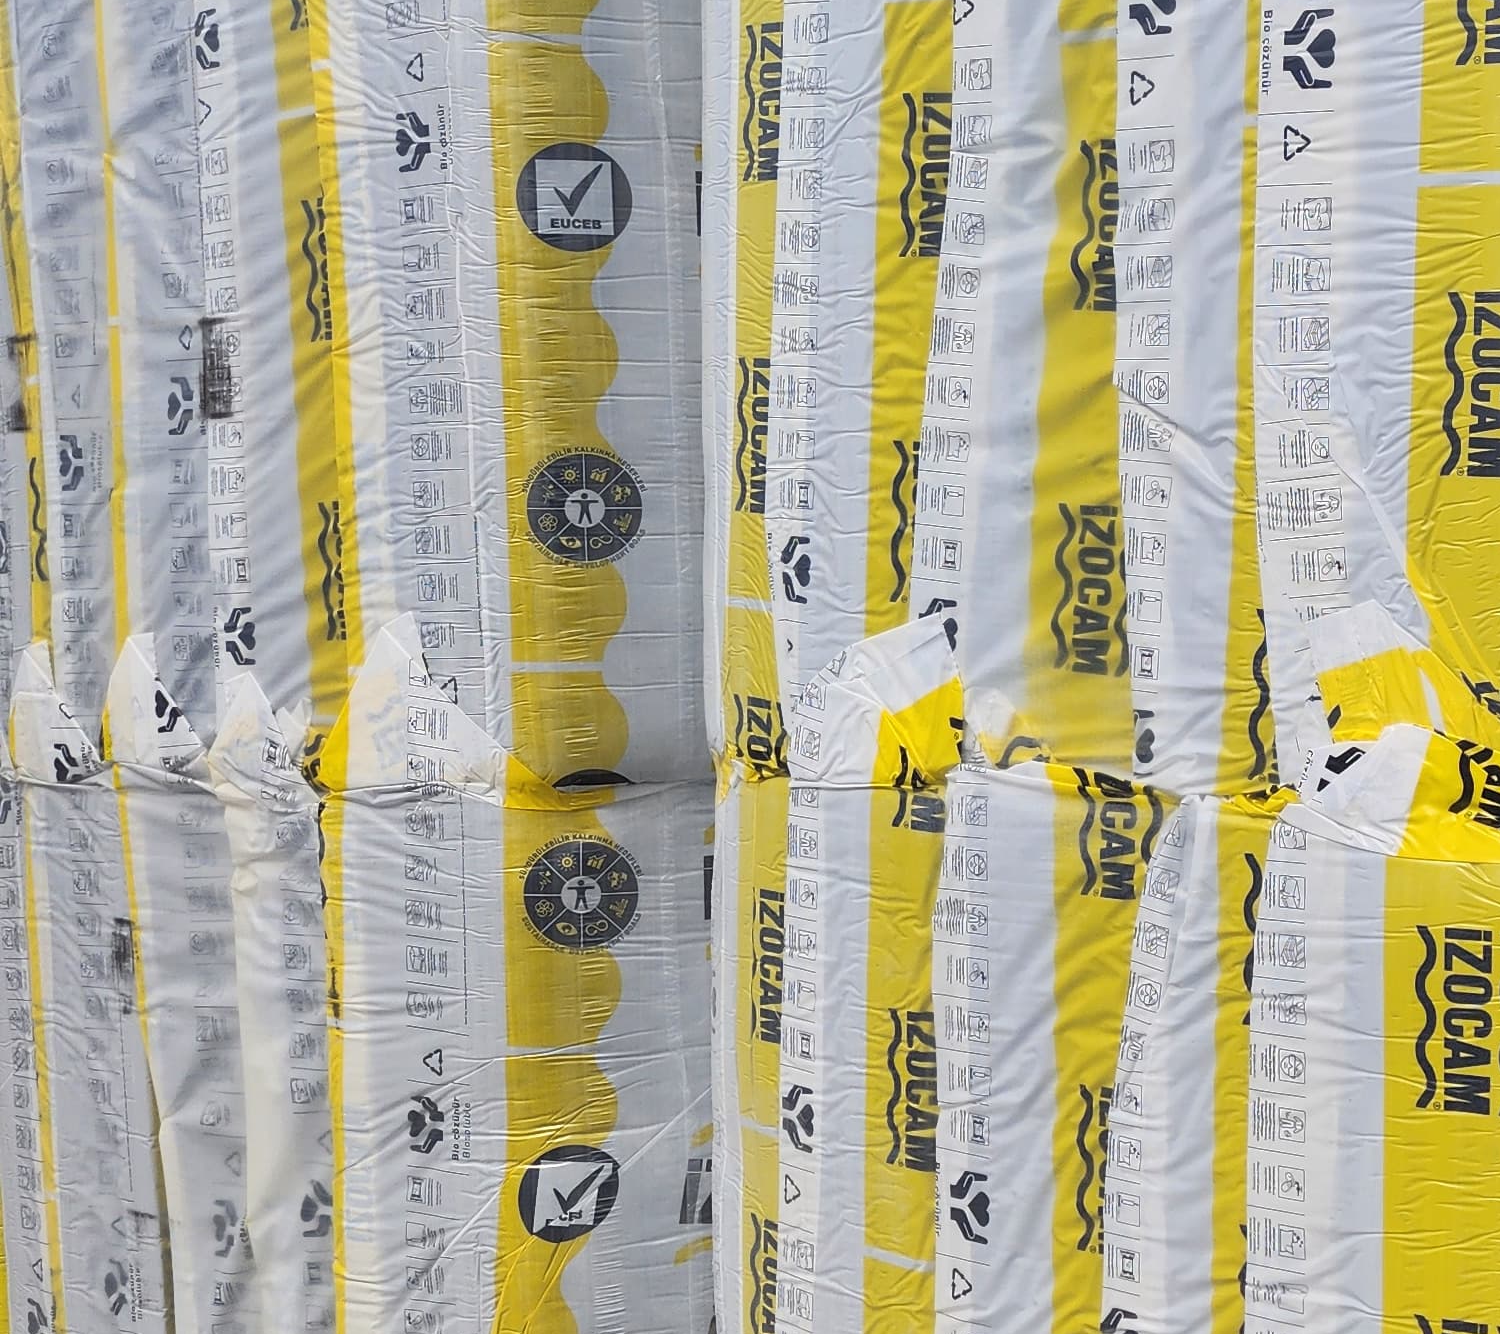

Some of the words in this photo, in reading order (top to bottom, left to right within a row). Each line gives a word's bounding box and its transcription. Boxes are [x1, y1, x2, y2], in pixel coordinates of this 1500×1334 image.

[1264, 10, 1272, 32] Bio
[1261, 38, 1272, 97] çözünür
[436, 104, 448, 148] çözünür
[440, 152, 448, 169] Bio
[550, 218, 602, 229] EUCEB
[575, 447, 616, 461] KALKINMA
[617, 458, 647, 492] HEDEFLERİ
[572, 834, 613, 847] KALKINMA
[615, 843, 643, 878] HEDEFLERİ
[1442, 927, 1492, 1115] İZOCAM
[452, 1097, 461, 1140] çözünür
[452, 1143, 460, 1161] Bio
